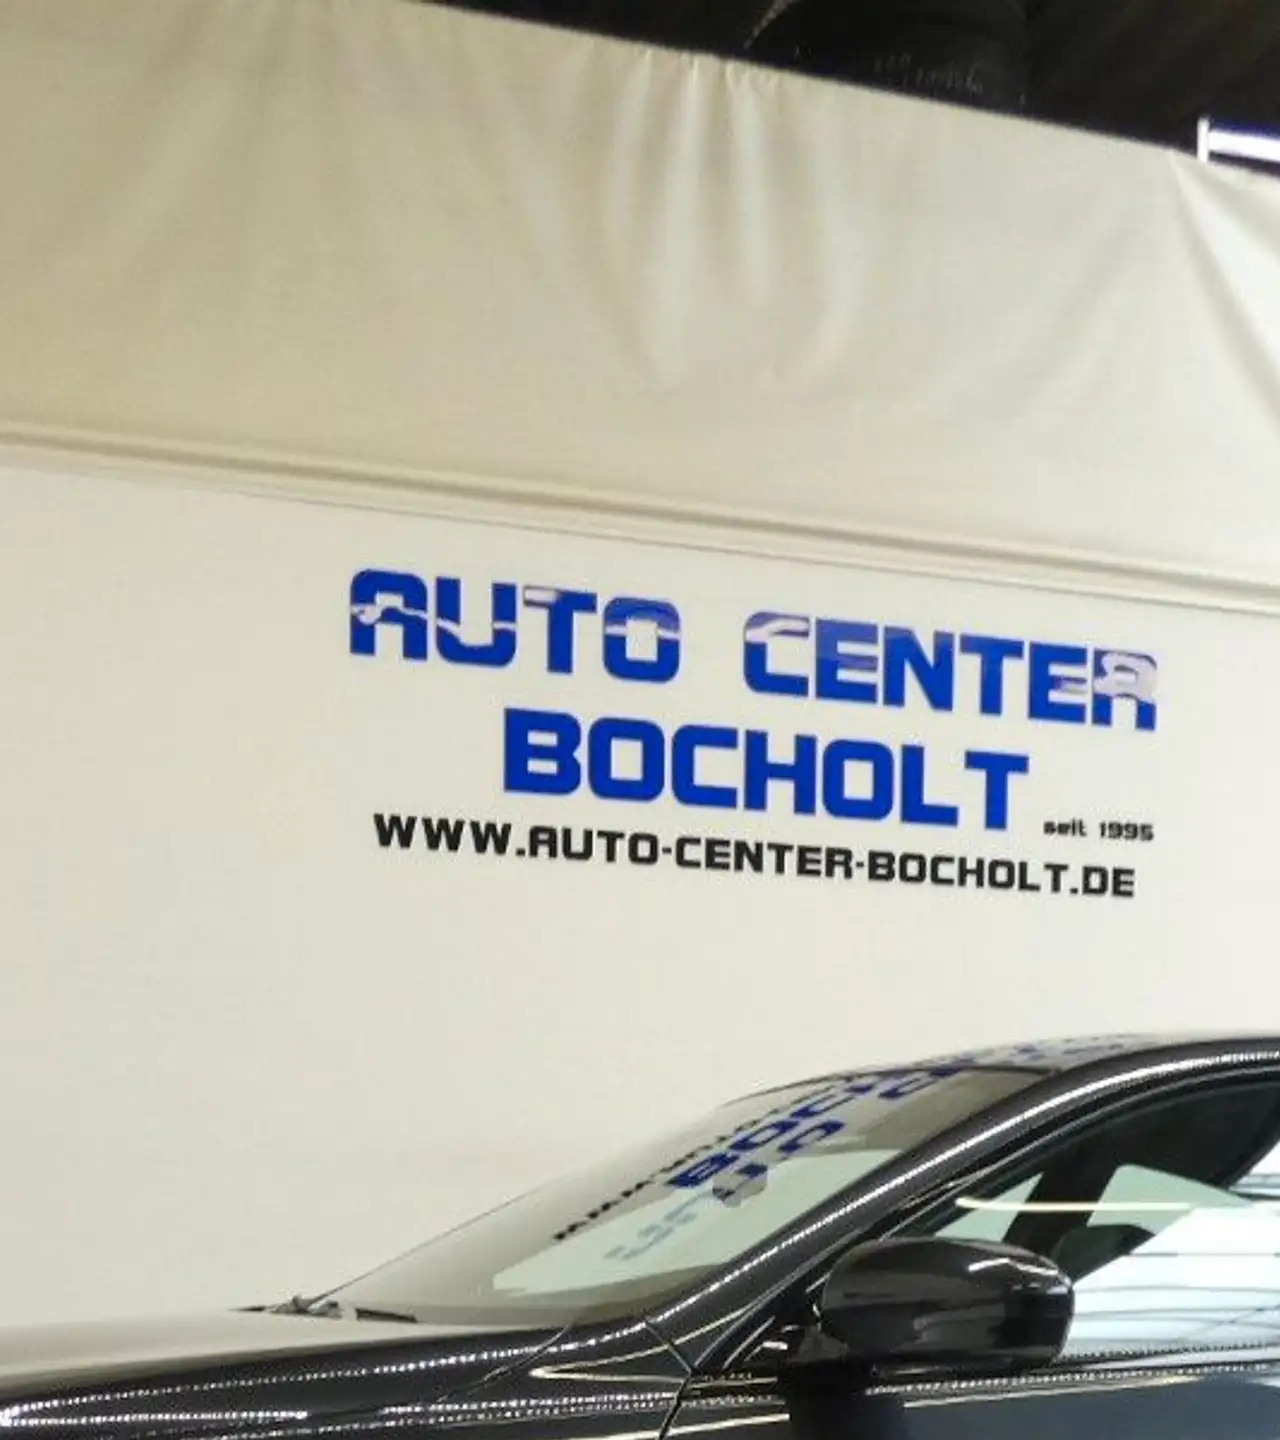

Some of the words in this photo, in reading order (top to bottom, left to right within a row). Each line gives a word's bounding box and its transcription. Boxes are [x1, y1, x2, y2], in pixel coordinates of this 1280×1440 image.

[349, 568, 682, 684] AUTO
[742, 610, 1159, 731] CENTER
[503, 706, 1030, 831] BOCHOLT
[373, 812, 1136, 898] WWW.AUTO-CENTER-BOCHOLT.DE
[1099, 821, 1155, 842] 1995
